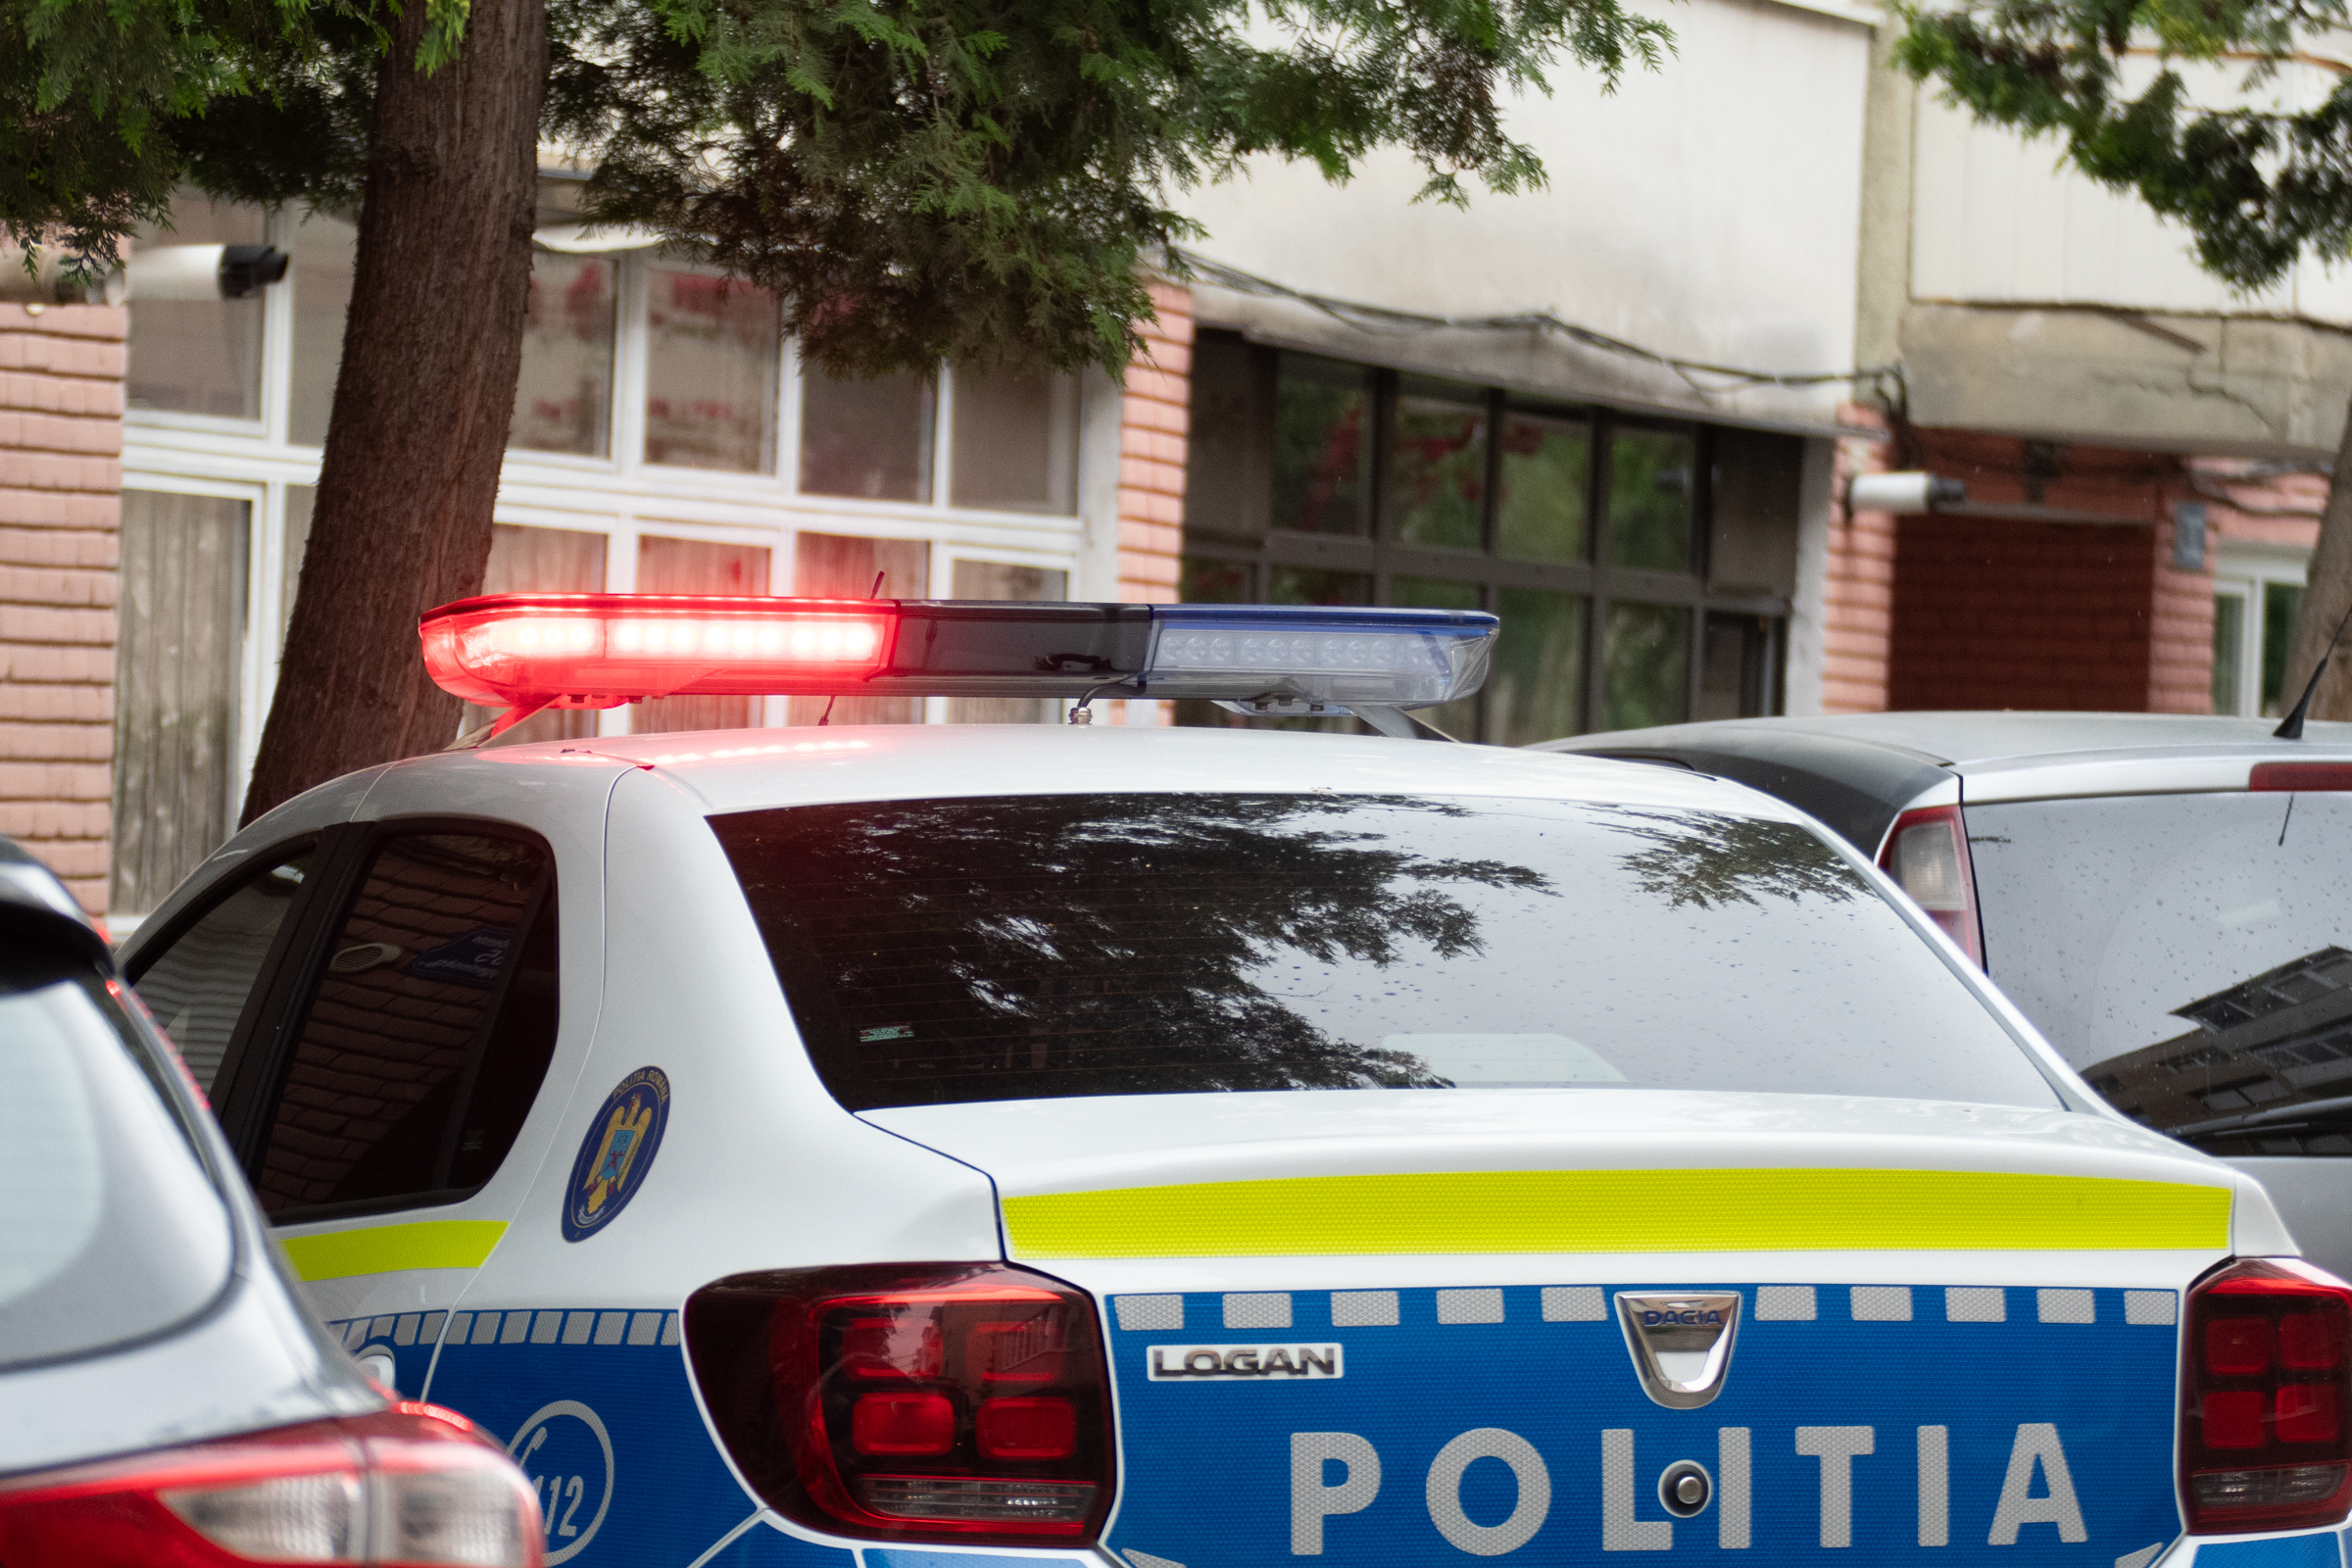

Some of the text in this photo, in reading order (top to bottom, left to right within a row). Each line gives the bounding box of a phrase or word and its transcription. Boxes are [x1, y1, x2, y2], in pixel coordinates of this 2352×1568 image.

[1642, 1309, 1723, 1326] DACIA
[1152, 1347, 1335, 1377] LOGAN
[1290, 1422, 2089, 1556] POLITIA
